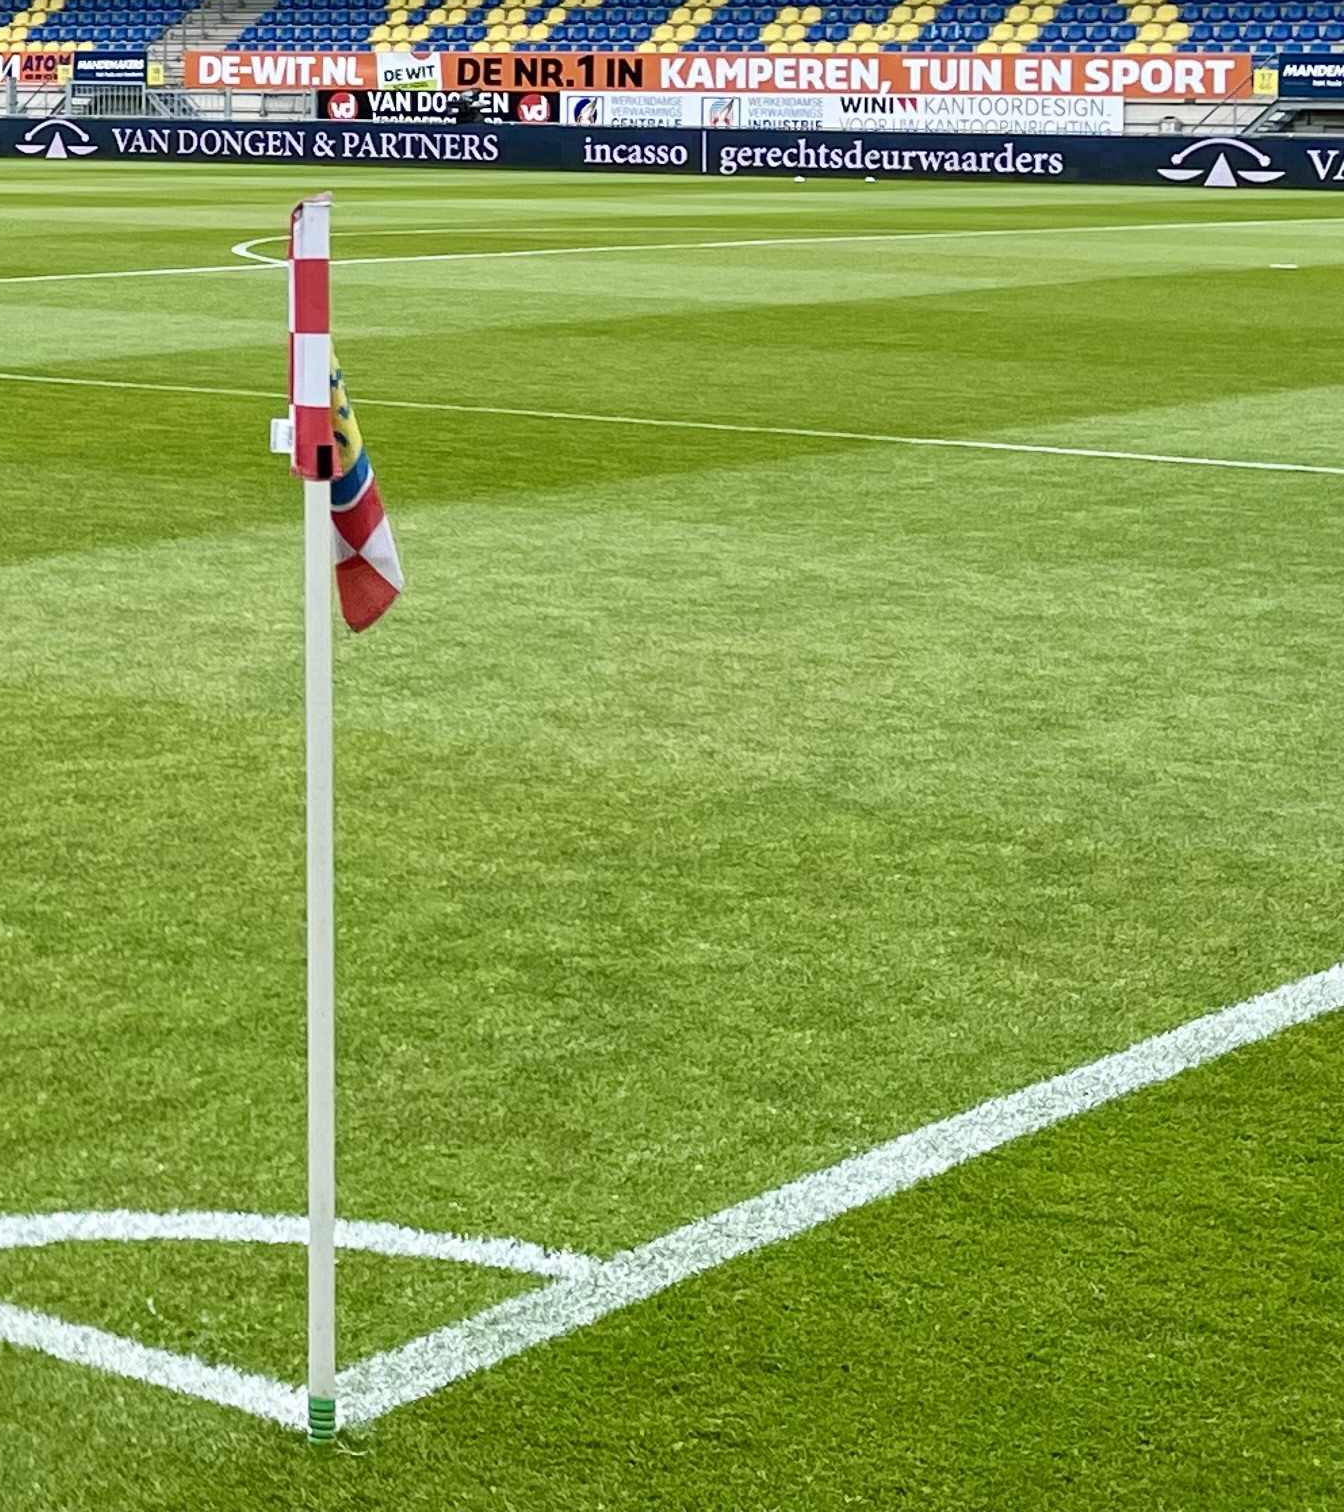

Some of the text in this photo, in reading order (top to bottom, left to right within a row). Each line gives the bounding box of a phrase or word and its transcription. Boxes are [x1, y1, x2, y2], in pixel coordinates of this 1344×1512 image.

[198, 55, 365, 86] DE-WIT.NL
[383, 65, 436, 82] DE WIT
[457, 54, 1235, 95] DE NR.1 IN KAMPEREN, TUIN EN SPORT
[367, 91, 412, 113] VAN
[611, 95, 683, 106] WERKENDAMSE
[747, 96, 824, 107] WERKENDAMSE
[840, 96, 895, 115] WINI
[611, 106, 683, 118] VERWARMINGS
[747, 107, 824, 119] VERWARMINGS
[111, 128, 500, 161] VAN DONGEN & PARTNERS
[583, 136, 688, 166] incasso
[719, 138, 1064, 175] gerechtsdeurwaarders
